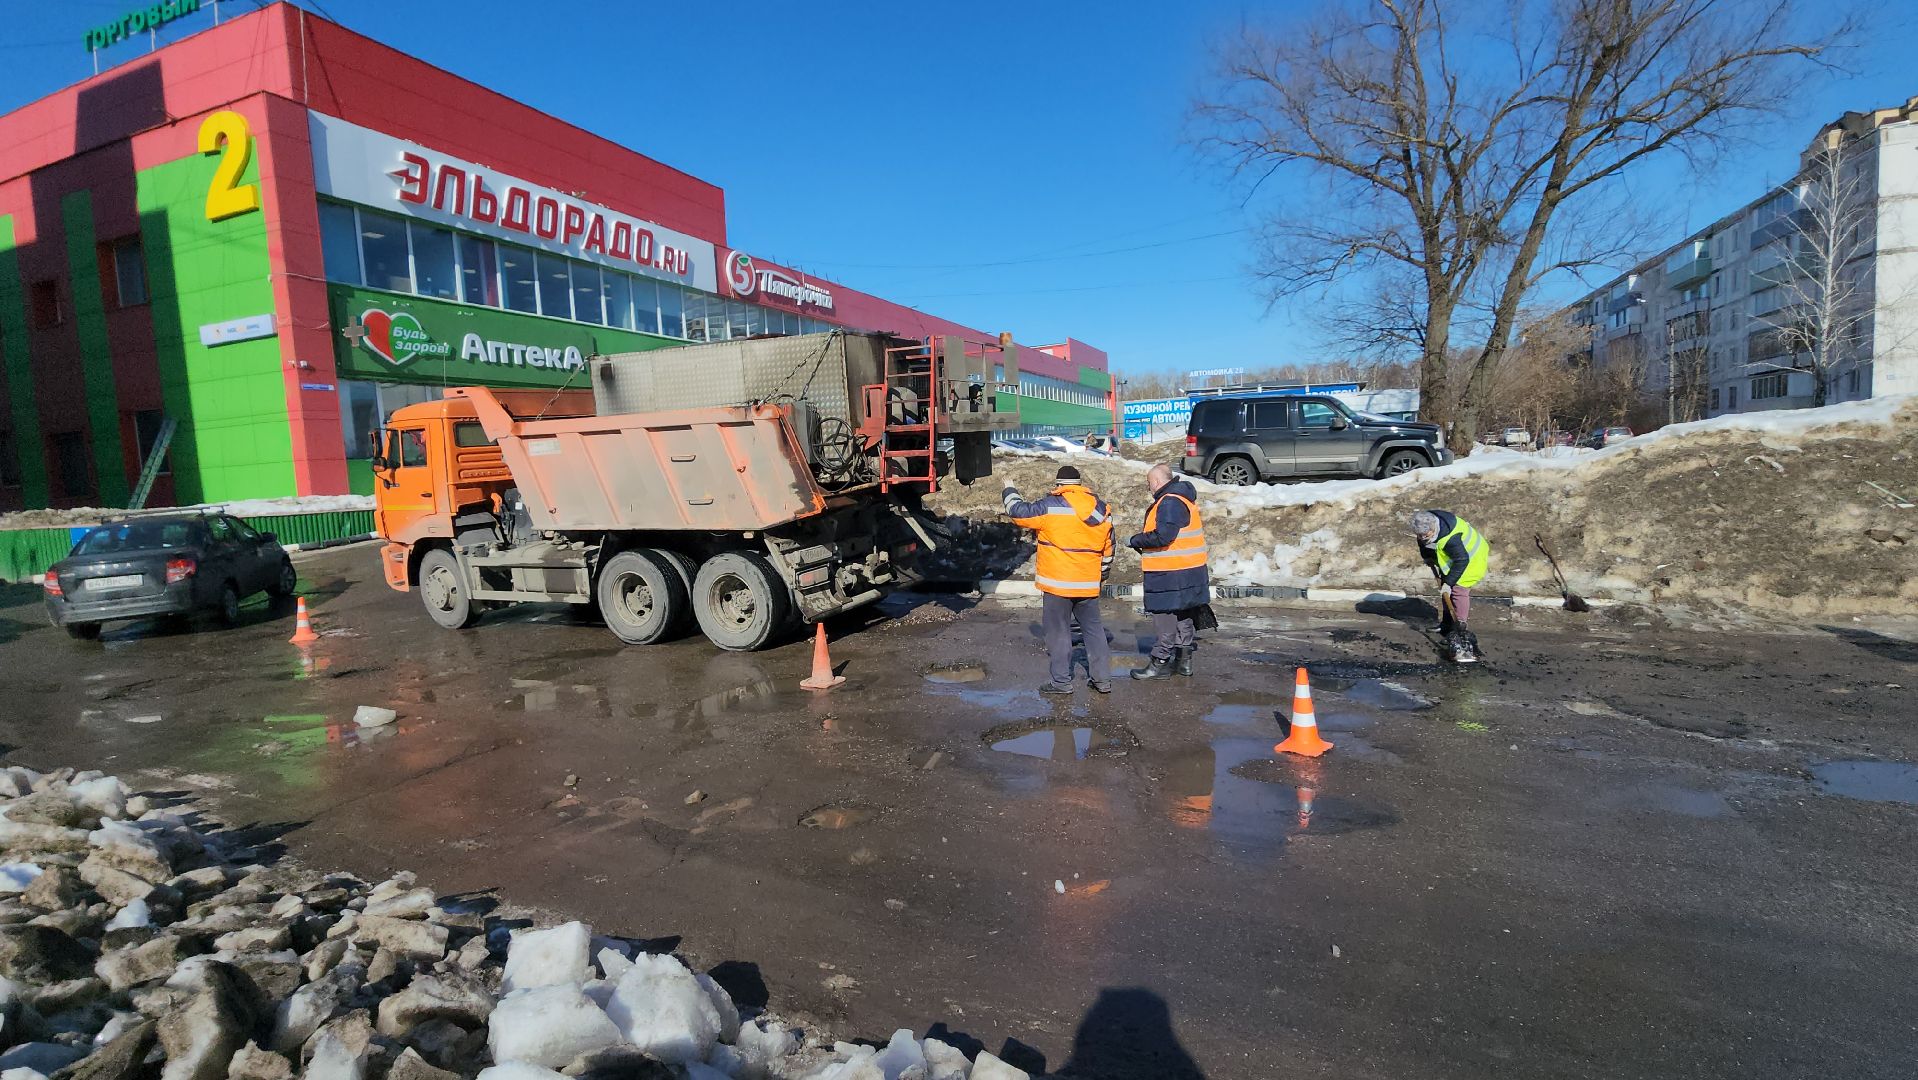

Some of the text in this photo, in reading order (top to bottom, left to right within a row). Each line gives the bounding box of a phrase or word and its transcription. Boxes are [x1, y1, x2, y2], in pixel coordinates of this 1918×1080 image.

[82, 0, 199, 52] ТОРГОВЫЙ
[198, 111, 259, 222] 2
[387, 151, 689, 276] ЭЛЬДОРАДО.RU
[756, 269, 833, 309] Пятерочка
[392, 326, 428, 341] Будь
[395, 340, 450, 354] здоров!
[1124, 401, 1172, 414] КУЗОВНОЙ
